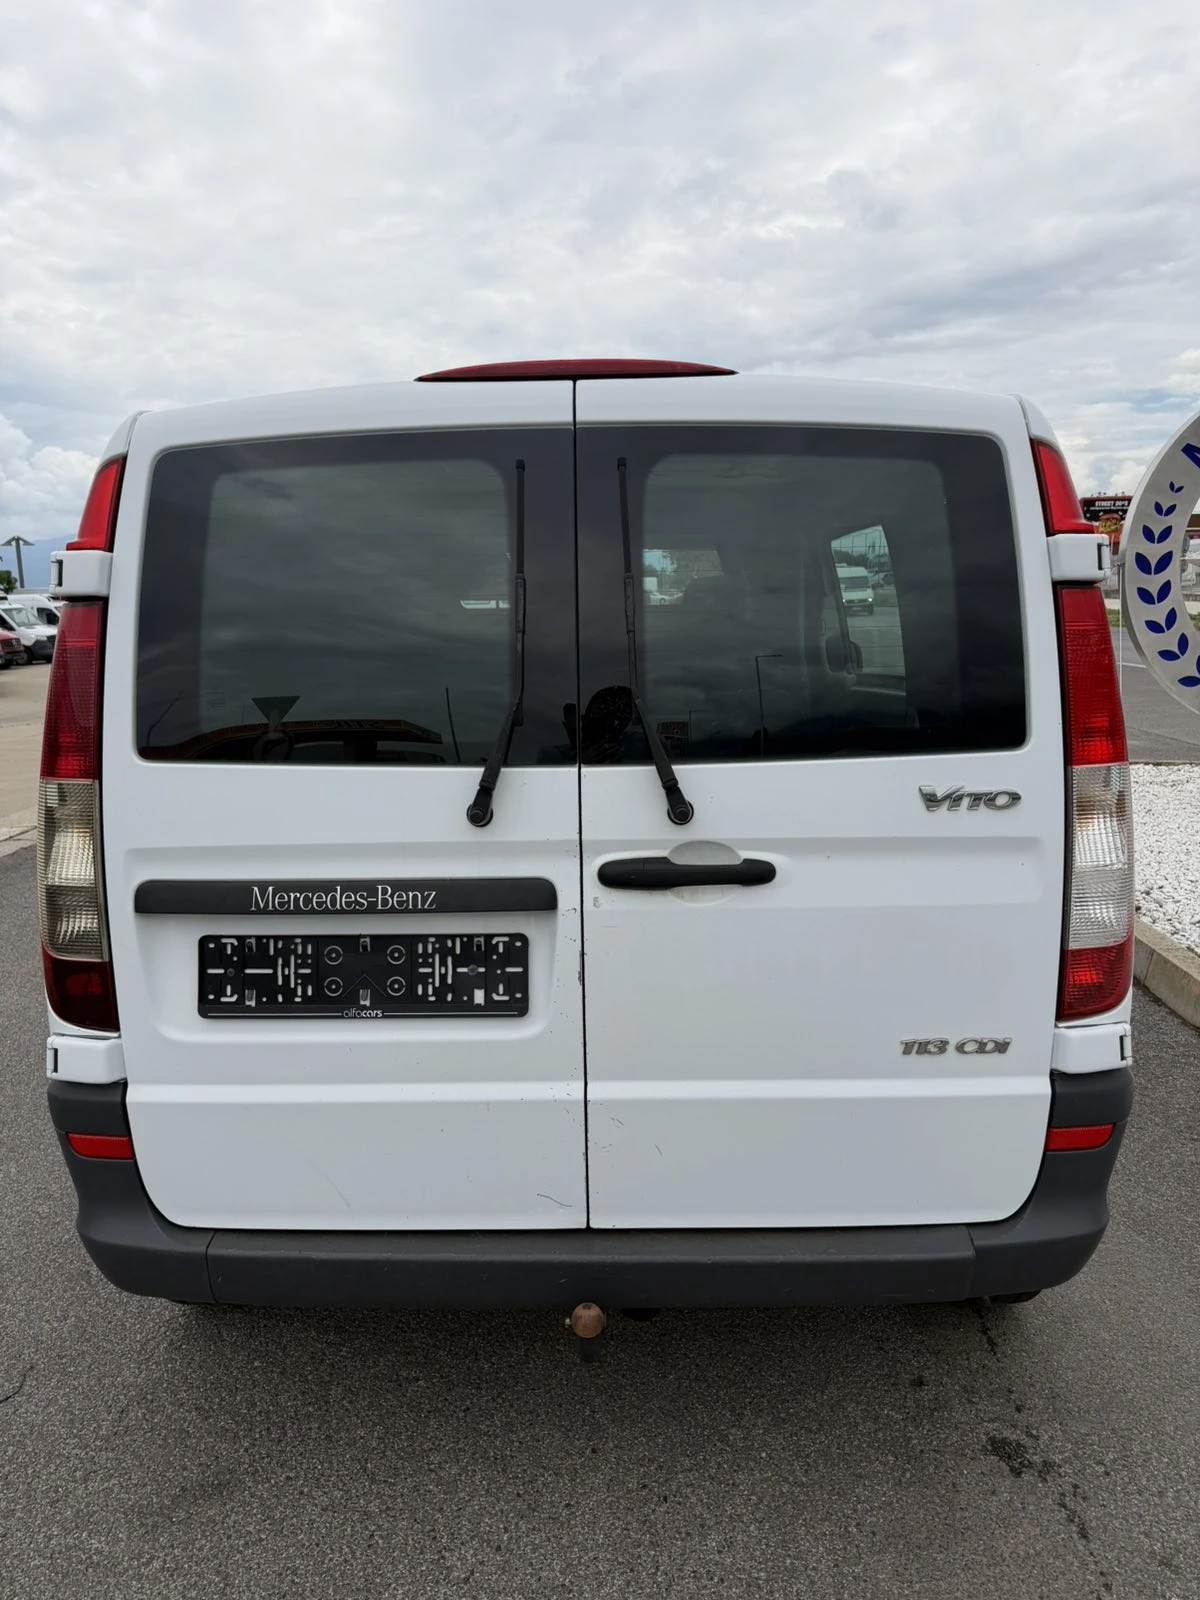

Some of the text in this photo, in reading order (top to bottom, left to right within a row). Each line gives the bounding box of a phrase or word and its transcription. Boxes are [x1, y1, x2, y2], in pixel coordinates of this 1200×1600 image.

[250, 885, 437, 911] Mercedes-Benz
[343, 1007, 383, 1018] alfacars
[900, 1038, 950, 1055] 113
